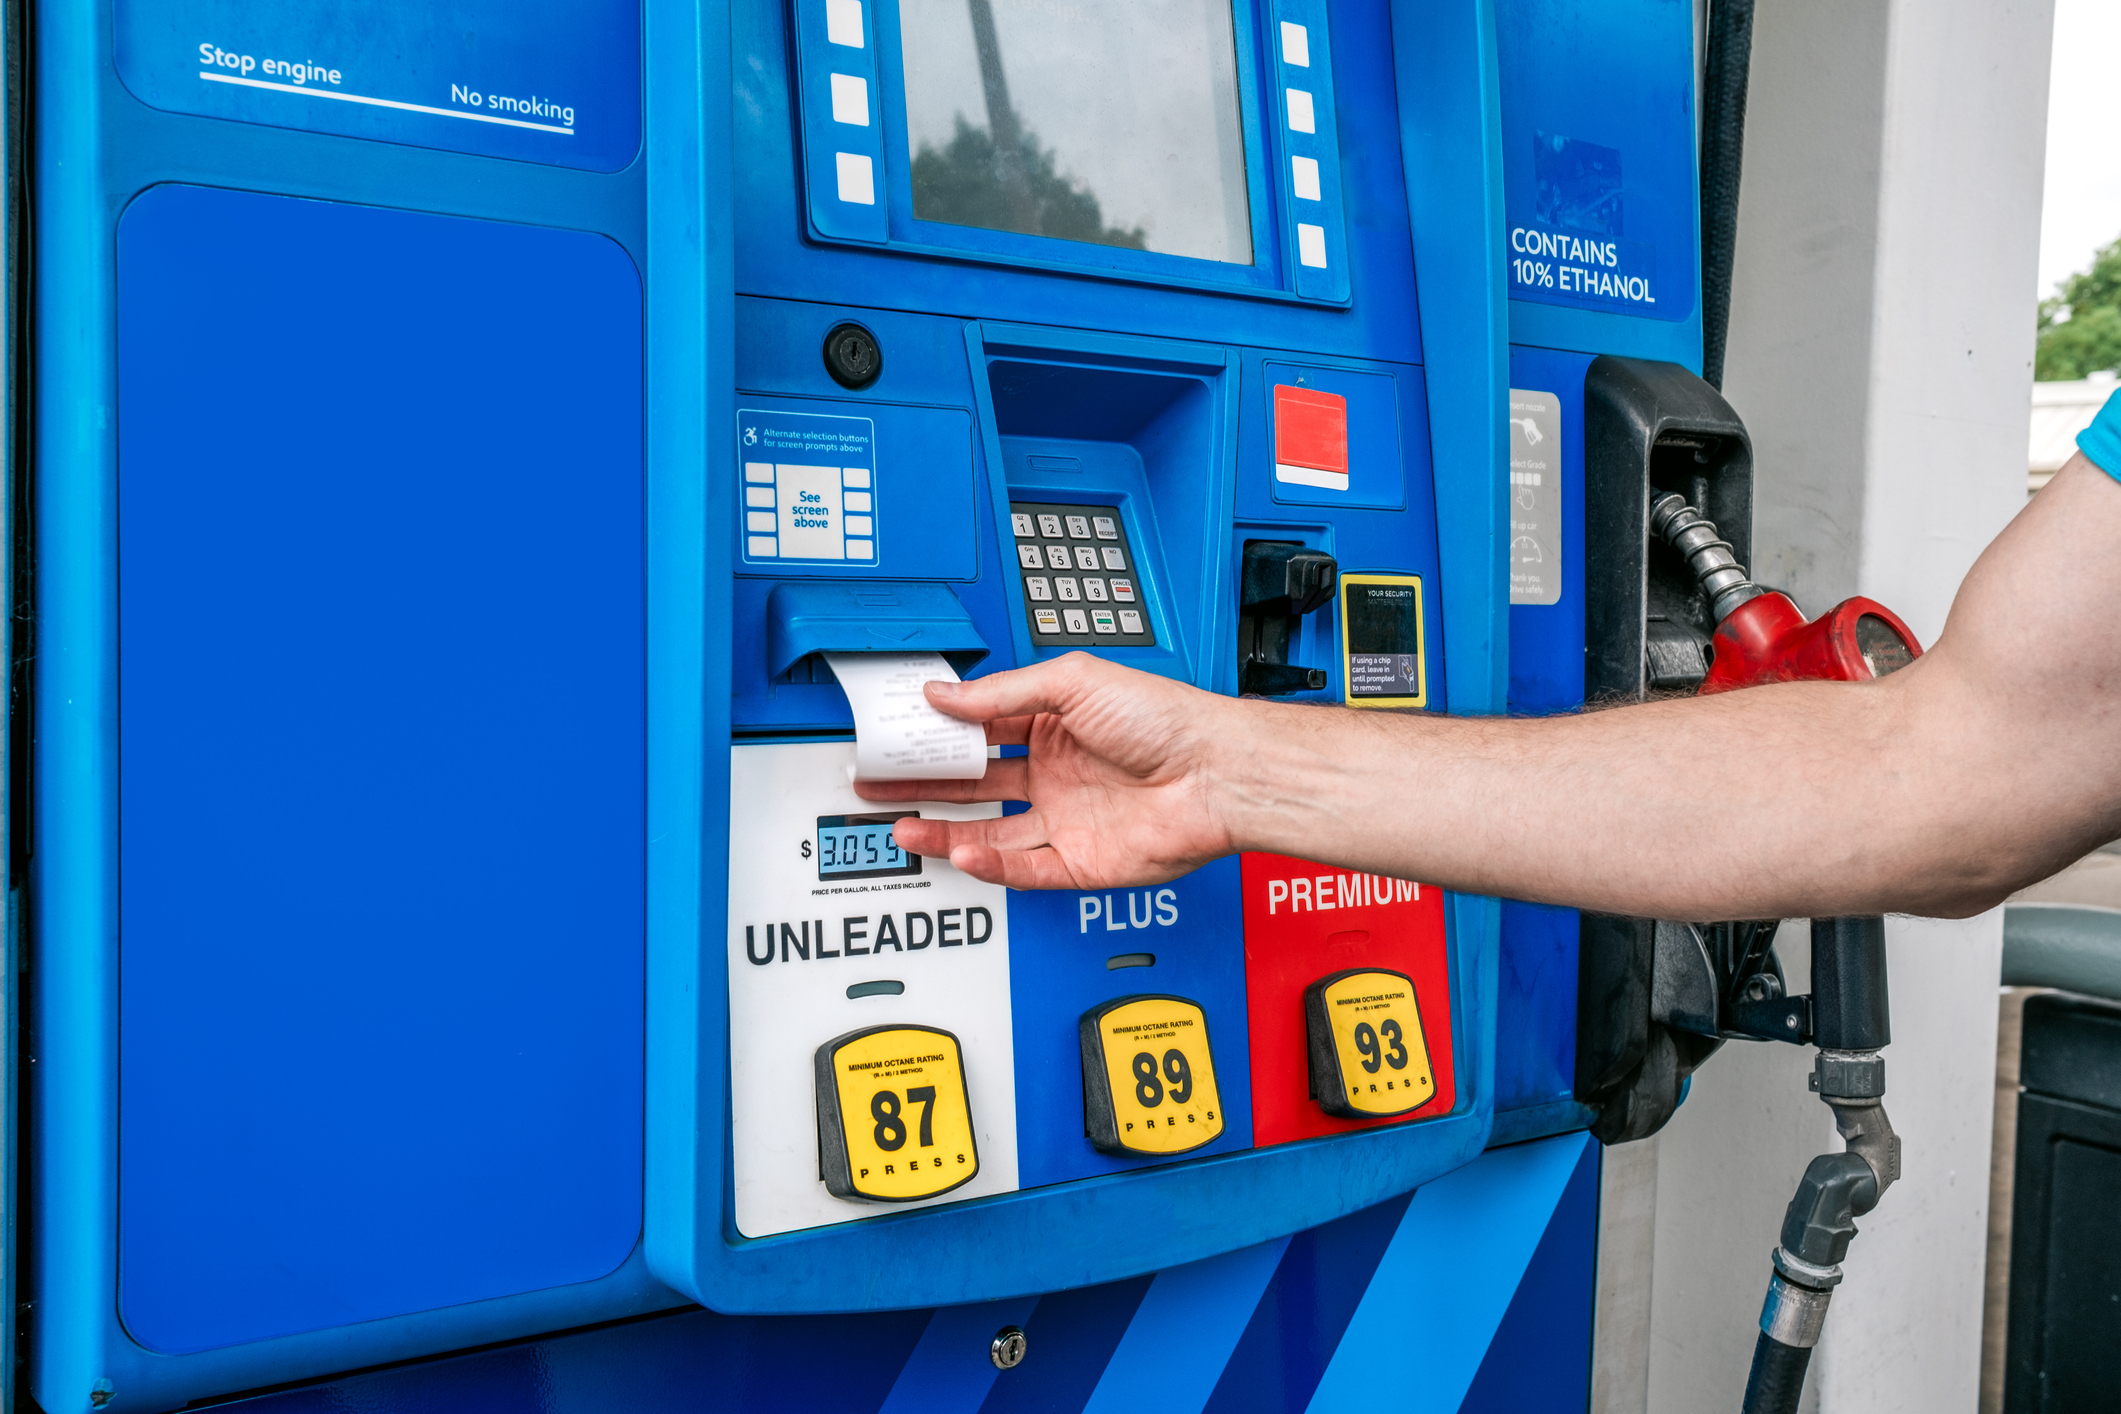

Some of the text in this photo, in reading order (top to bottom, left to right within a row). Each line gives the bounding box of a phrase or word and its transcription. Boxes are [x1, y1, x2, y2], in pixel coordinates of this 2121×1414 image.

[199, 43, 342, 85] Stop engine
[451, 83, 574, 126] No smoking
[1512, 227, 1618, 268] CONTAINS
[1513, 258, 1655, 303] 10% ETHANOL
[1525, 403, 1546, 412] nozzle
[763, 428, 869, 443] Alternate selection buttons
[764, 438, 864, 453] for screen prompts above
[1527, 460, 1546, 469] Grade
[799, 490, 821, 503] See
[792, 506, 829, 516] screen
[794, 516, 829, 528] above
[1019, 523, 1026, 533] 1
[1518, 523, 1526, 531] up
[1048, 524, 1056, 534] 2
[1076, 525, 1084, 535] 3
[1028, 555, 1036, 565] 4
[1057, 555, 1065, 566] 5
[1085, 556, 1093, 567] 6
[1036, 587, 1043, 597] 7
[1065, 587, 1073, 598] 8
[1093, 588, 1101, 598] 9
[1367, 590, 1413, 598] YOUR SECURITY
[1074, 619, 1081, 630] 0
[1351, 656, 1356, 664] If
[1356, 657, 1373, 666] using
[1378, 656, 1391, 666] chip
[1366, 675, 1395, 684] prompted
[801, 839, 812, 860] $
[902, 881, 931, 889] INCLUDED
[1268, 873, 1420, 915] PREMIUM
[1079, 888, 1179, 934] PLUS
[745, 906, 993, 966] UNLEADED
[1336, 992, 1405, 1006] MINIMUM OCTANE RATING
[1112, 1019, 1194, 1034] MINIMUM OCTANE RATING
[1156, 1031, 1176, 1039] METHOD
[1354, 1018, 1408, 1074] 93
[848, 1054, 945, 1072] MINIMUM OCTANE RATING
[900, 1067, 923, 1075] METHOD
[1132, 1048, 1192, 1108] 89
[1352, 1076, 1427, 1096] PRESS
[870, 1085, 937, 1152] 87
[1126, 1111, 1215, 1132] PRESS
[860, 1153, 966, 1179] PRESS
